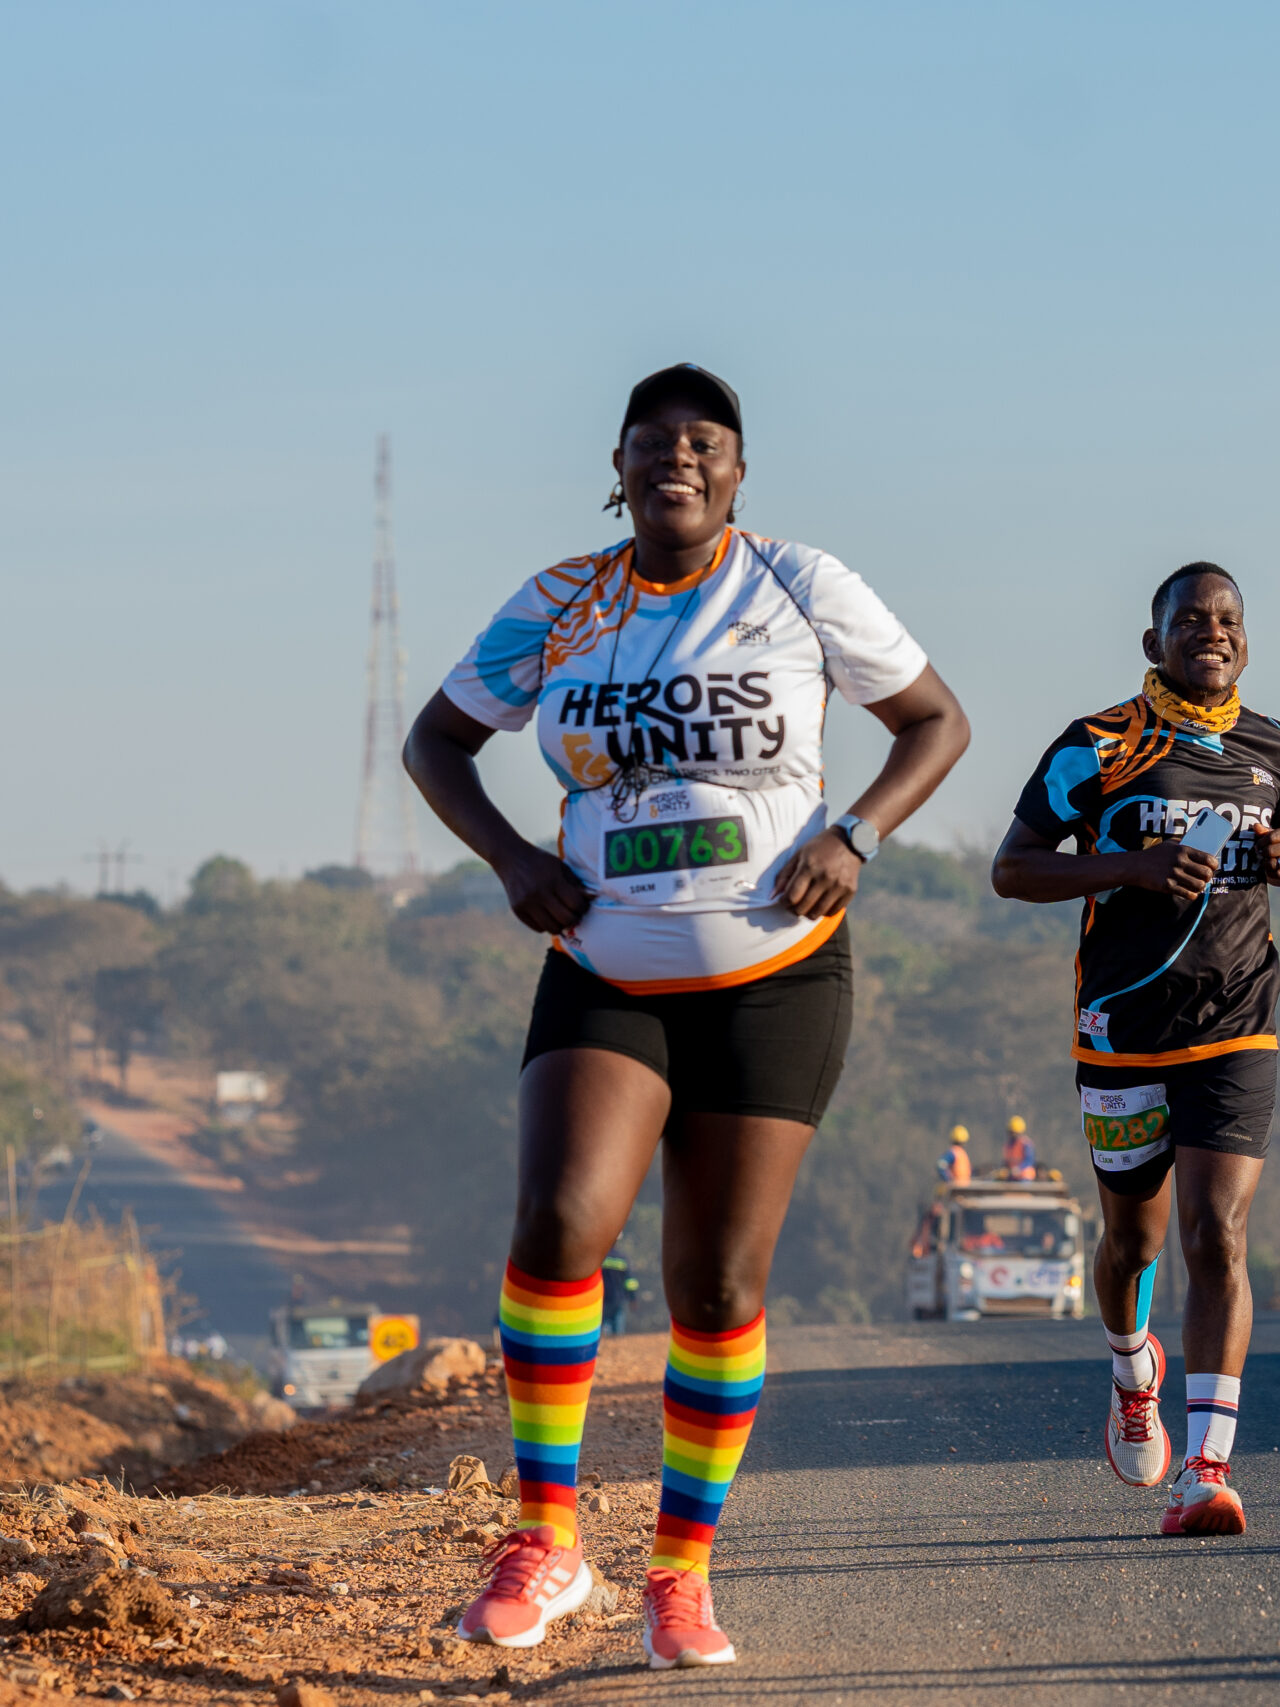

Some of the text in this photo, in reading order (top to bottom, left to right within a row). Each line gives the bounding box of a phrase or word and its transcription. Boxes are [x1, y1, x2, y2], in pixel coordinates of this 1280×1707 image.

[559, 671, 773, 728] HEROES
[606, 715, 785, 771] UNITY
[725, 767, 750, 777] TWO
[608, 820, 743, 873] 00763
[1090, 1025, 1105, 1033] CITY
[1106, 1101, 1127, 1110] UNITY
[1085, 1112, 1167, 1147] 01282
